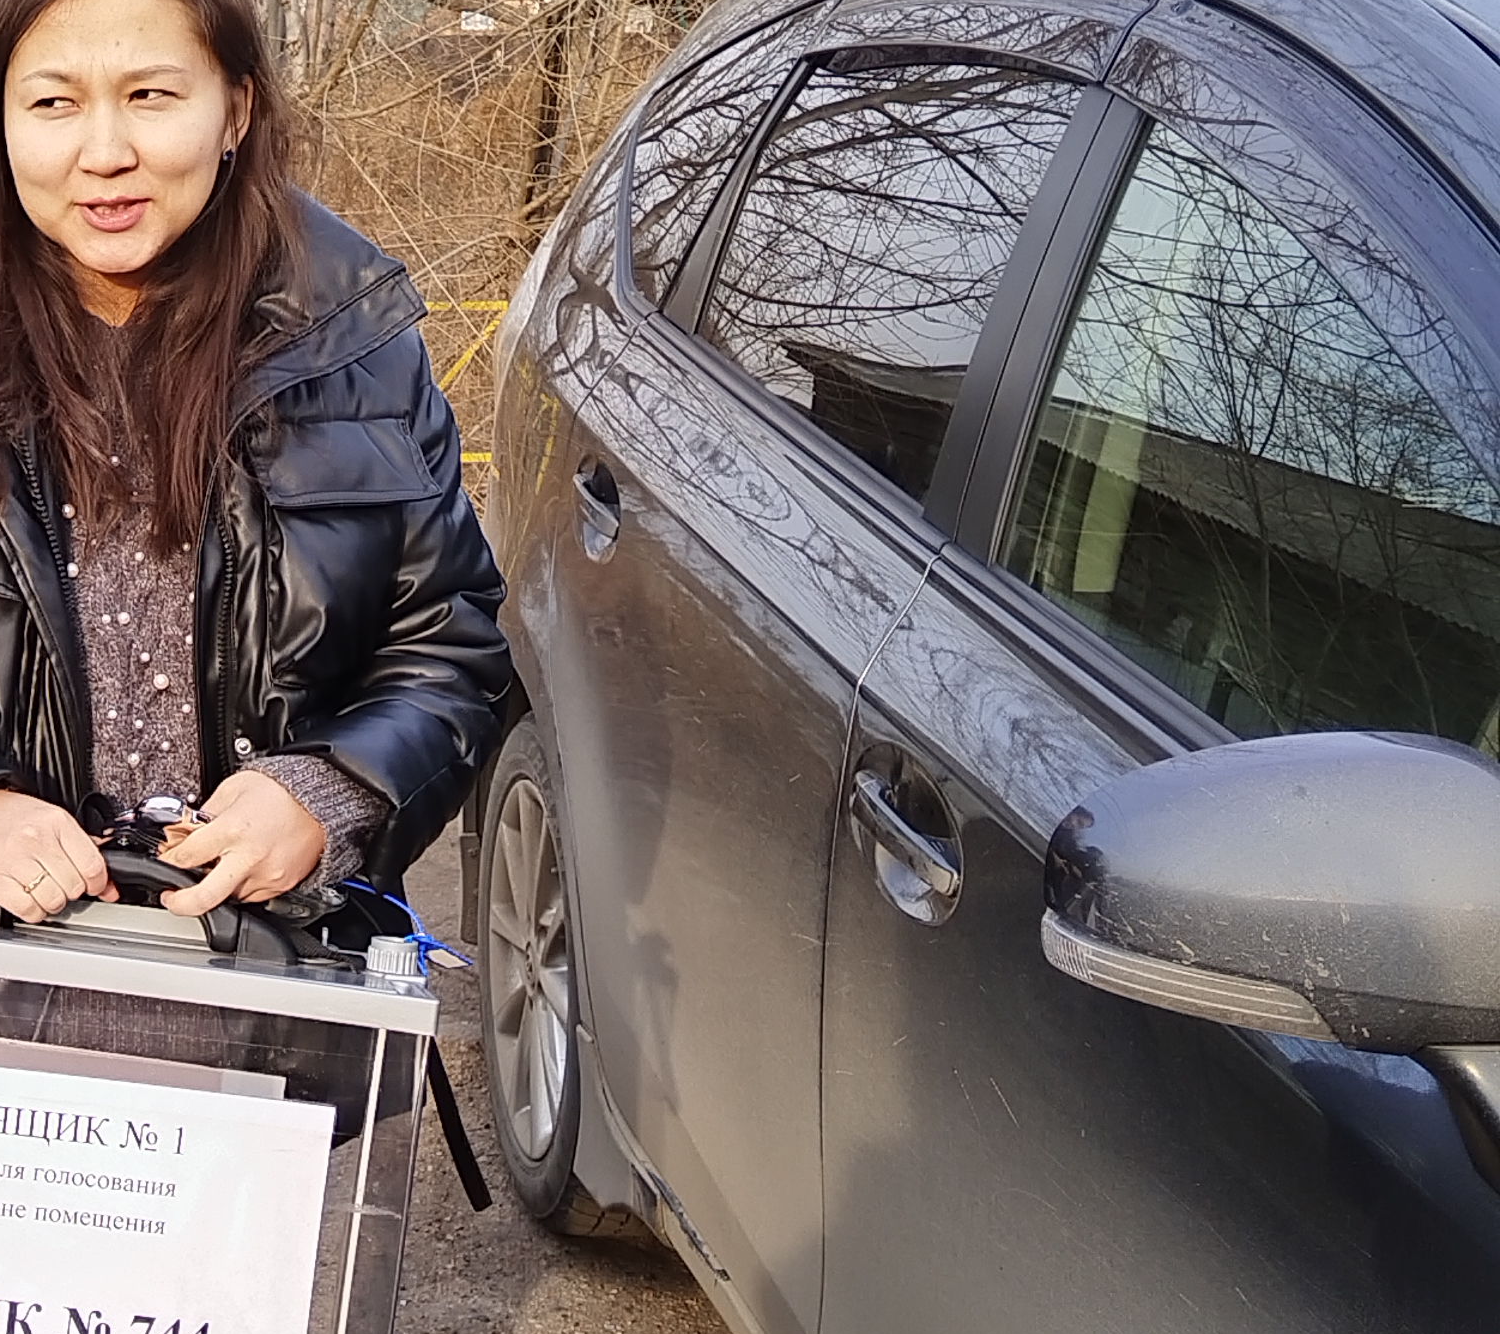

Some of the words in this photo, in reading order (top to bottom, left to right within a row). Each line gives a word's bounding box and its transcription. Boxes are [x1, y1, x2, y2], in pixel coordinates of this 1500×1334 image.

[119, 1120, 159, 1152] №
[174, 1126, 185, 1156] 1
[33, 1167, 177, 1198] голосования
[35, 1206, 166, 1235] помещения
